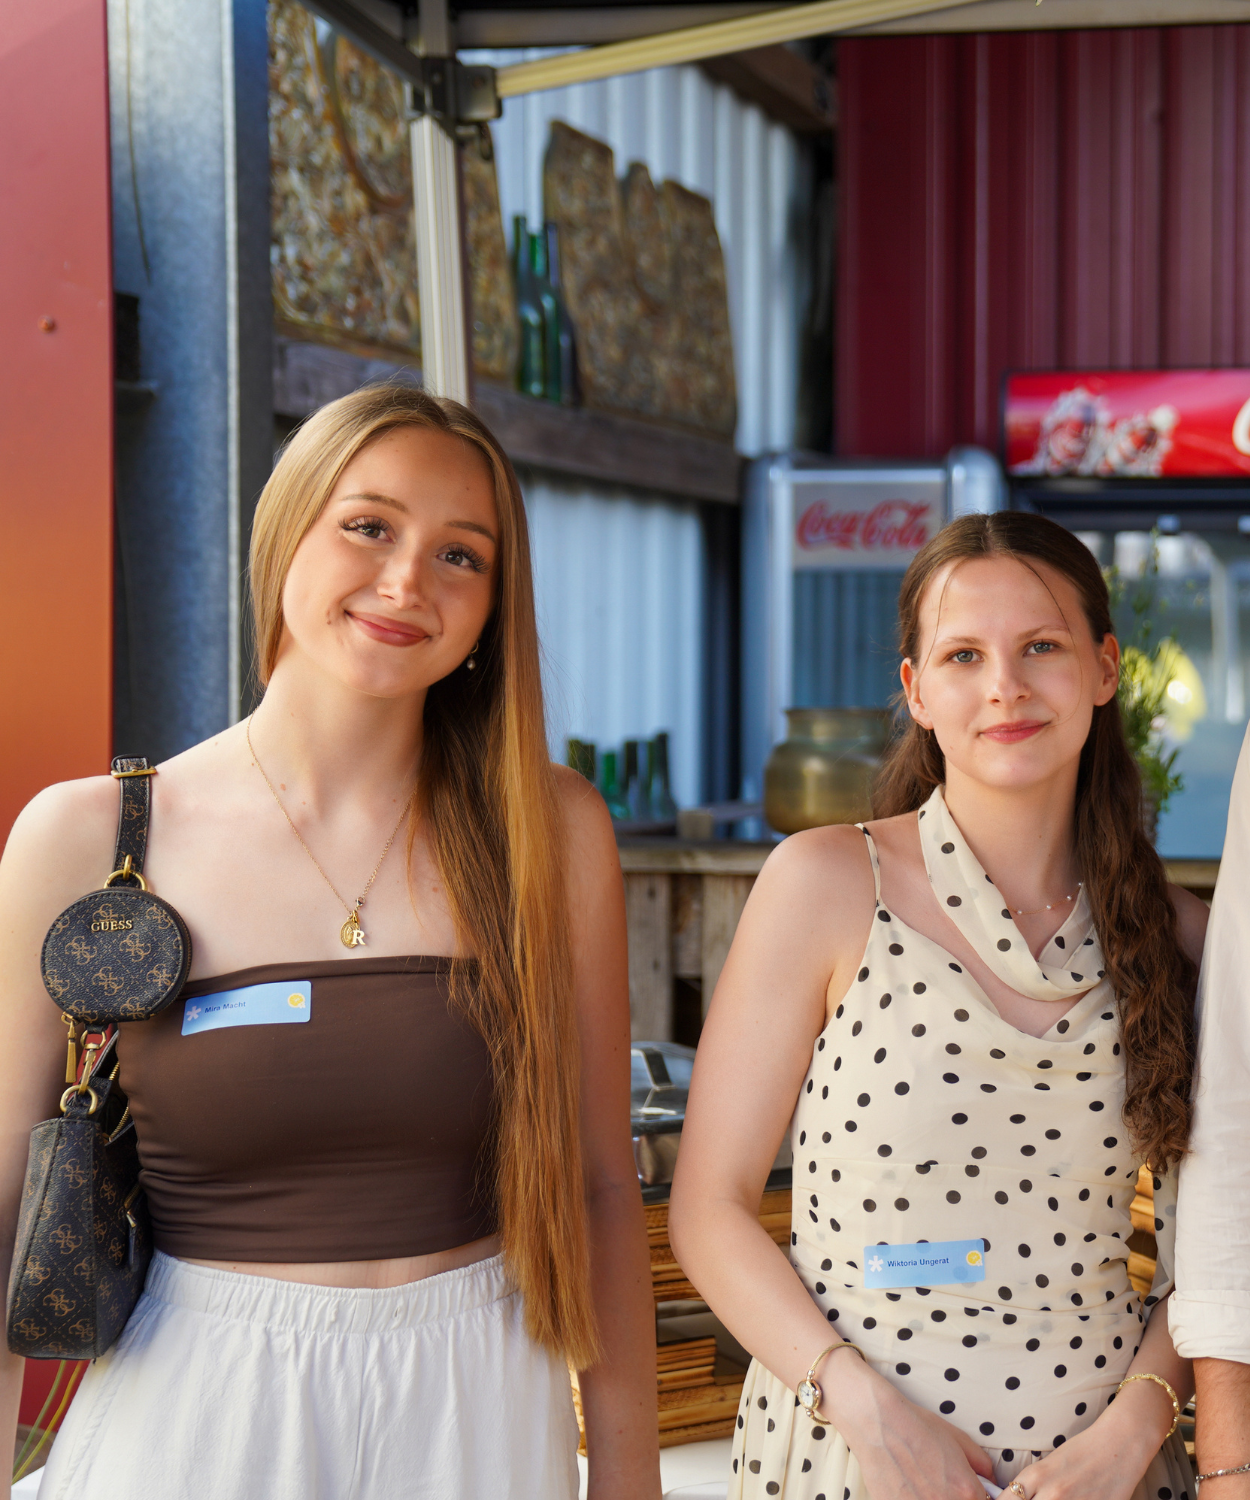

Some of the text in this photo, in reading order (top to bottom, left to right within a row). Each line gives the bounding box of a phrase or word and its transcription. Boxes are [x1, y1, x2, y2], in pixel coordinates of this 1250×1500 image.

[91, 920, 133, 931] GUESS
[351, 930, 366, 945] R
[222, 1001, 246, 1010] Macht
[887, 1258, 950, 1267] Wiktoria Ungerat
